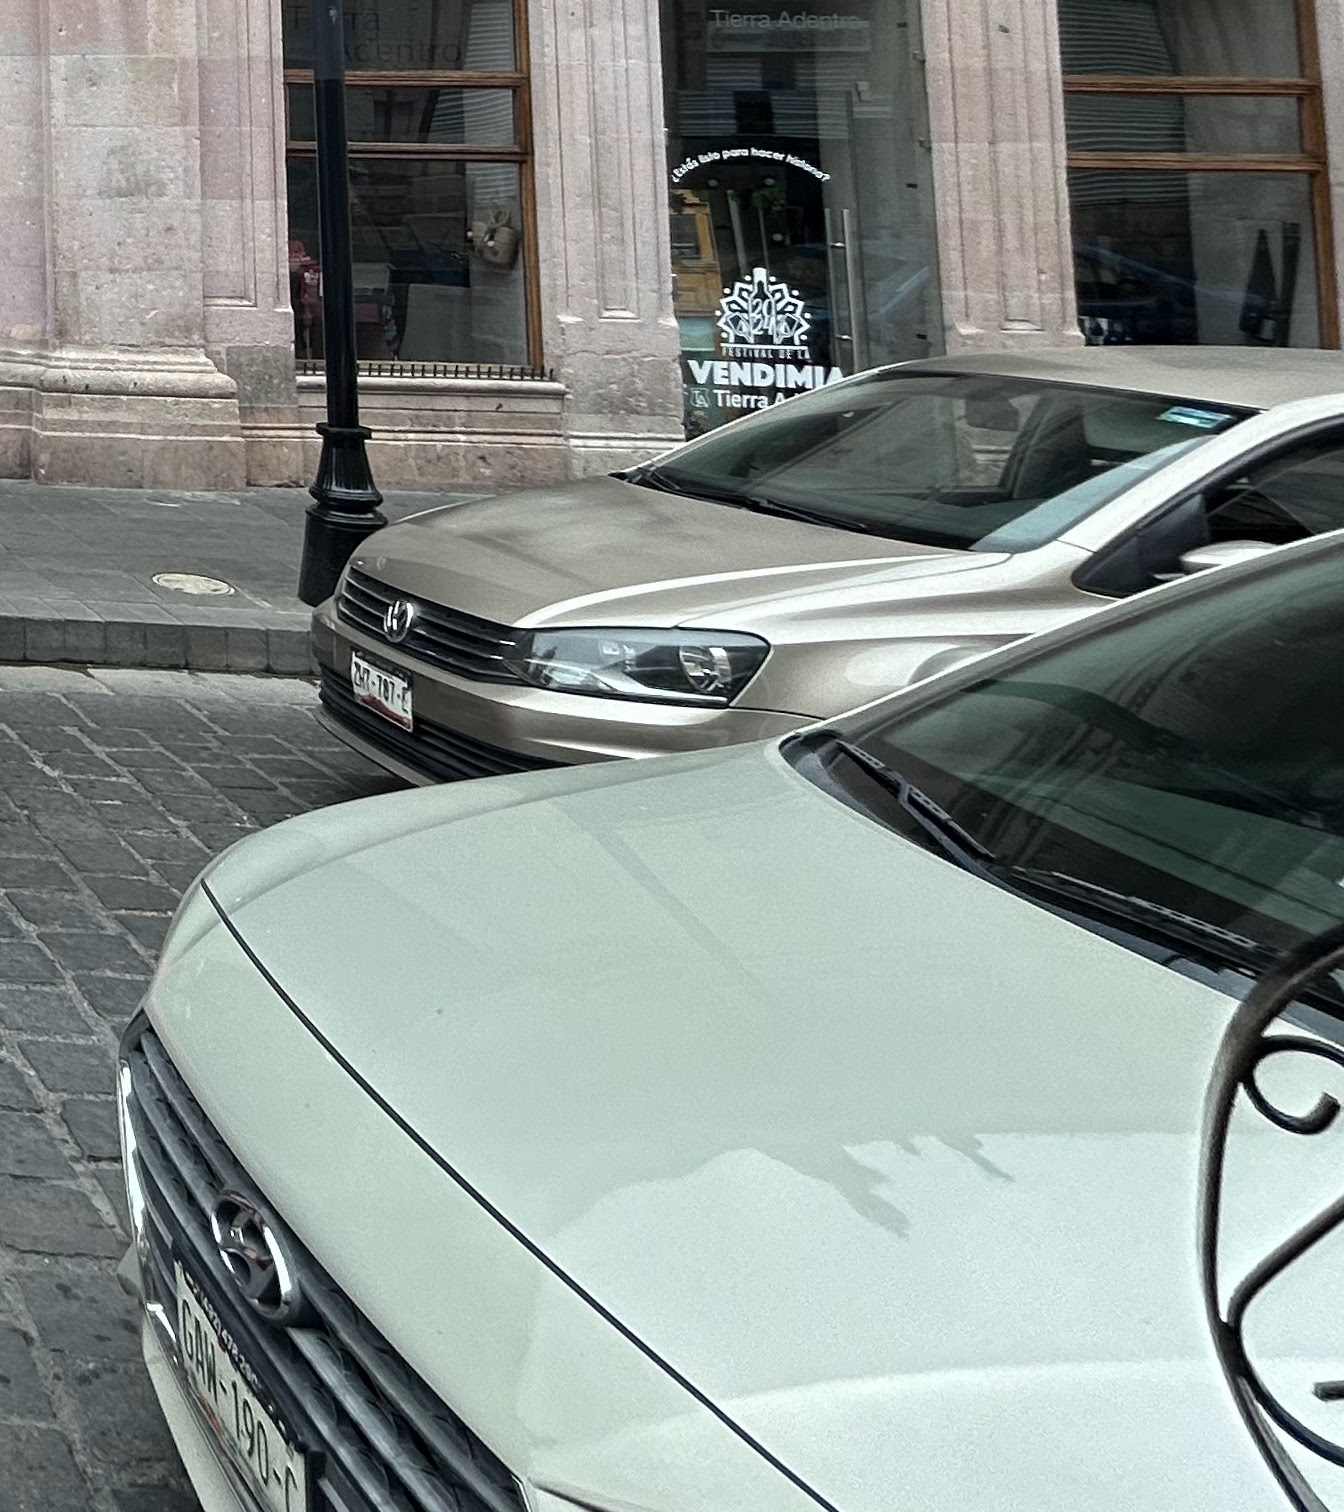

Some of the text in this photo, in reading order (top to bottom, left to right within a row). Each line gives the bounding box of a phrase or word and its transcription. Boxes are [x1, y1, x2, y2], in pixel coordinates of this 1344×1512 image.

[709, 9, 862, 29] Tierra Adentro
[722, 148, 749, 159] para
[750, 147, 786, 161] hacer
[722, 347, 811, 359] FESTIVAL DE LA
[687, 359, 844, 389] VENDIMIA
[713, 389, 768, 409] Tierra
